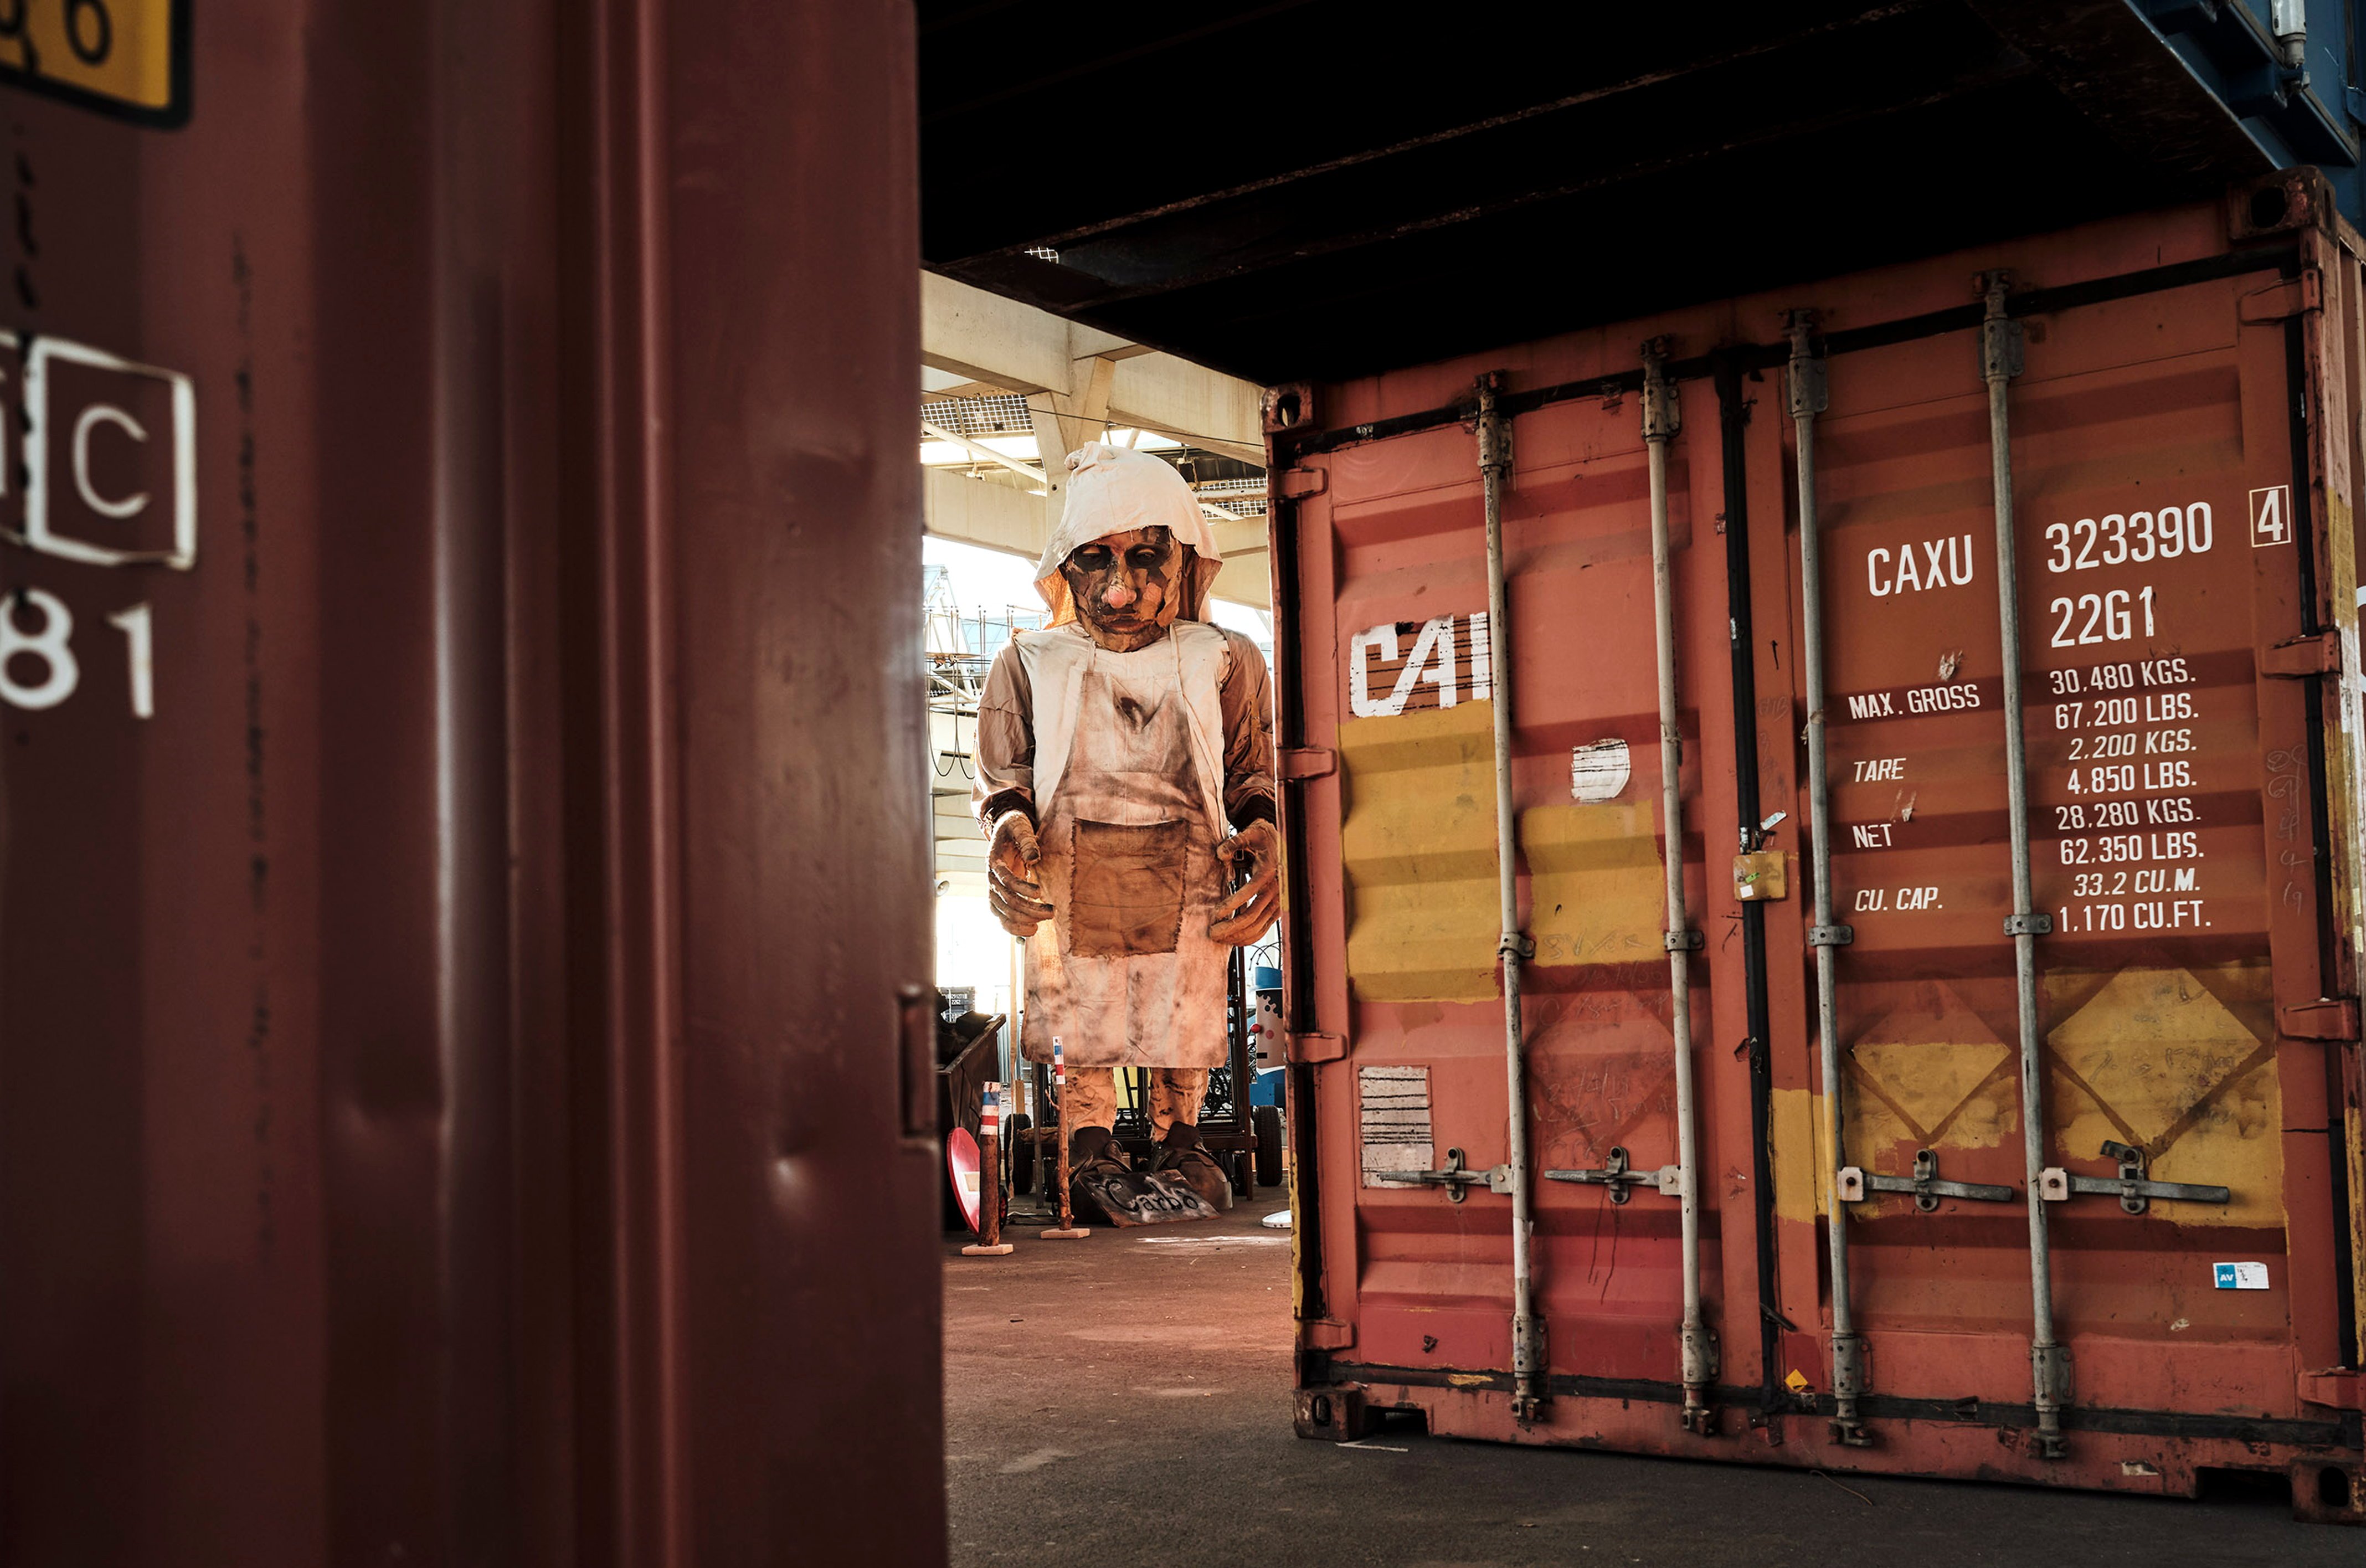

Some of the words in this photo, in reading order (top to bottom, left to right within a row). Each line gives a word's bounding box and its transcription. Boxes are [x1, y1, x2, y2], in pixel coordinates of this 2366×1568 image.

[1868, 534, 1973, 597] CAXU
[2045, 502, 2213, 573] 323390
[2257, 489, 2283, 541] 4
[2050, 585, 2154, 647] 22G1
[1848, 692, 1903, 719] MAX.
[1907, 684, 1981, 713] GROSS
[2141, 658, 2196, 686] KGS.
[2146, 692, 2199, 722] LBS.
[1854, 758, 1906, 783] TARE
[2144, 728, 2197, 754] KGS.
[2144, 760, 2197, 790] LBS.
[1852, 824, 1892, 848] NET
[2146, 798, 2201, 824] KGS.
[2151, 831, 2204, 860] LBS.
[1855, 889, 1888, 911] CU.
[1896, 887, 1943, 910] CAP.
[2074, 871, 2127, 897] 33.2
[2134, 867, 2200, 893] CU.M.
[2133, 900, 2211, 929] CU.FT.
